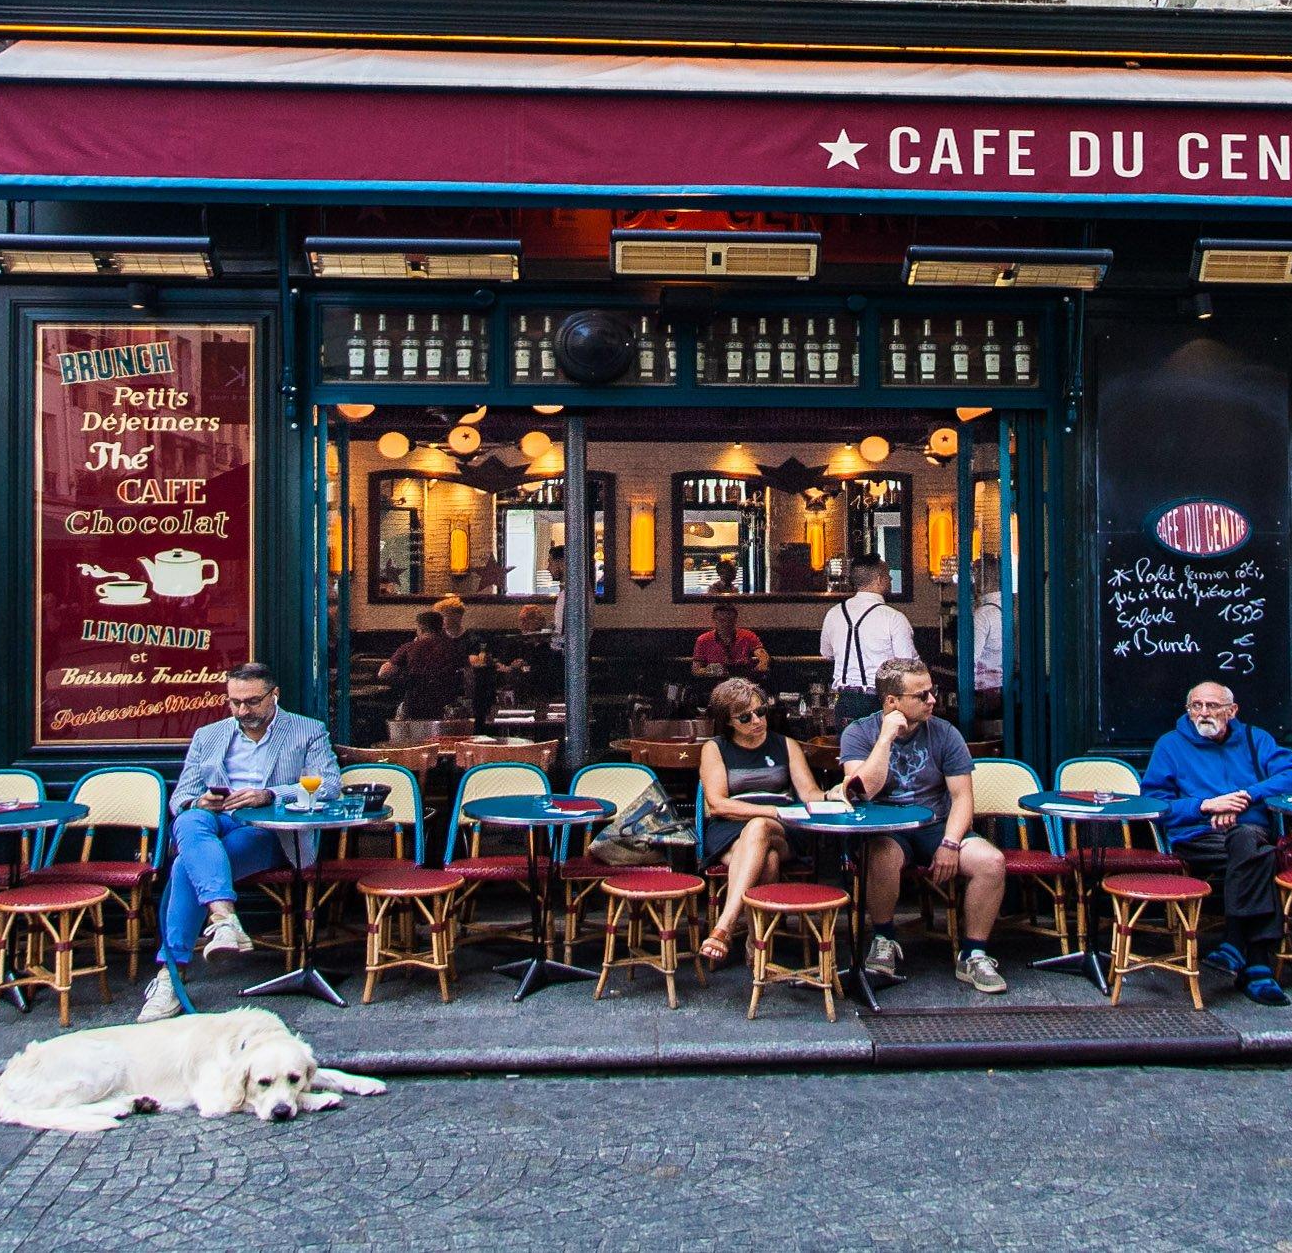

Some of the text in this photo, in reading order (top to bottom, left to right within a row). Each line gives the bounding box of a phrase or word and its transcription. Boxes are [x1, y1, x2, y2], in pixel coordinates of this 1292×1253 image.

[889, 126, 1036, 176] CAFE
[1069, 130, 1144, 179] DU
[57, 341, 175, 385] BRUNCH
[112, 386, 189, 410] Petits
[80, 411, 220, 435] Déjeuners
[85, 441, 155, 471] Thé
[117, 479, 206, 504] CAFE
[65, 509, 229, 538] Chocolat
[1157, 504, 1245, 553] CAFE DU CENTRE
[81, 619, 211, 650] LIMONADE
[130, 652, 148, 663] et
[1217, 651, 1255, 674] 23
[60, 668, 147, 686] Boissons
[165, 691, 229, 714] Maiso
